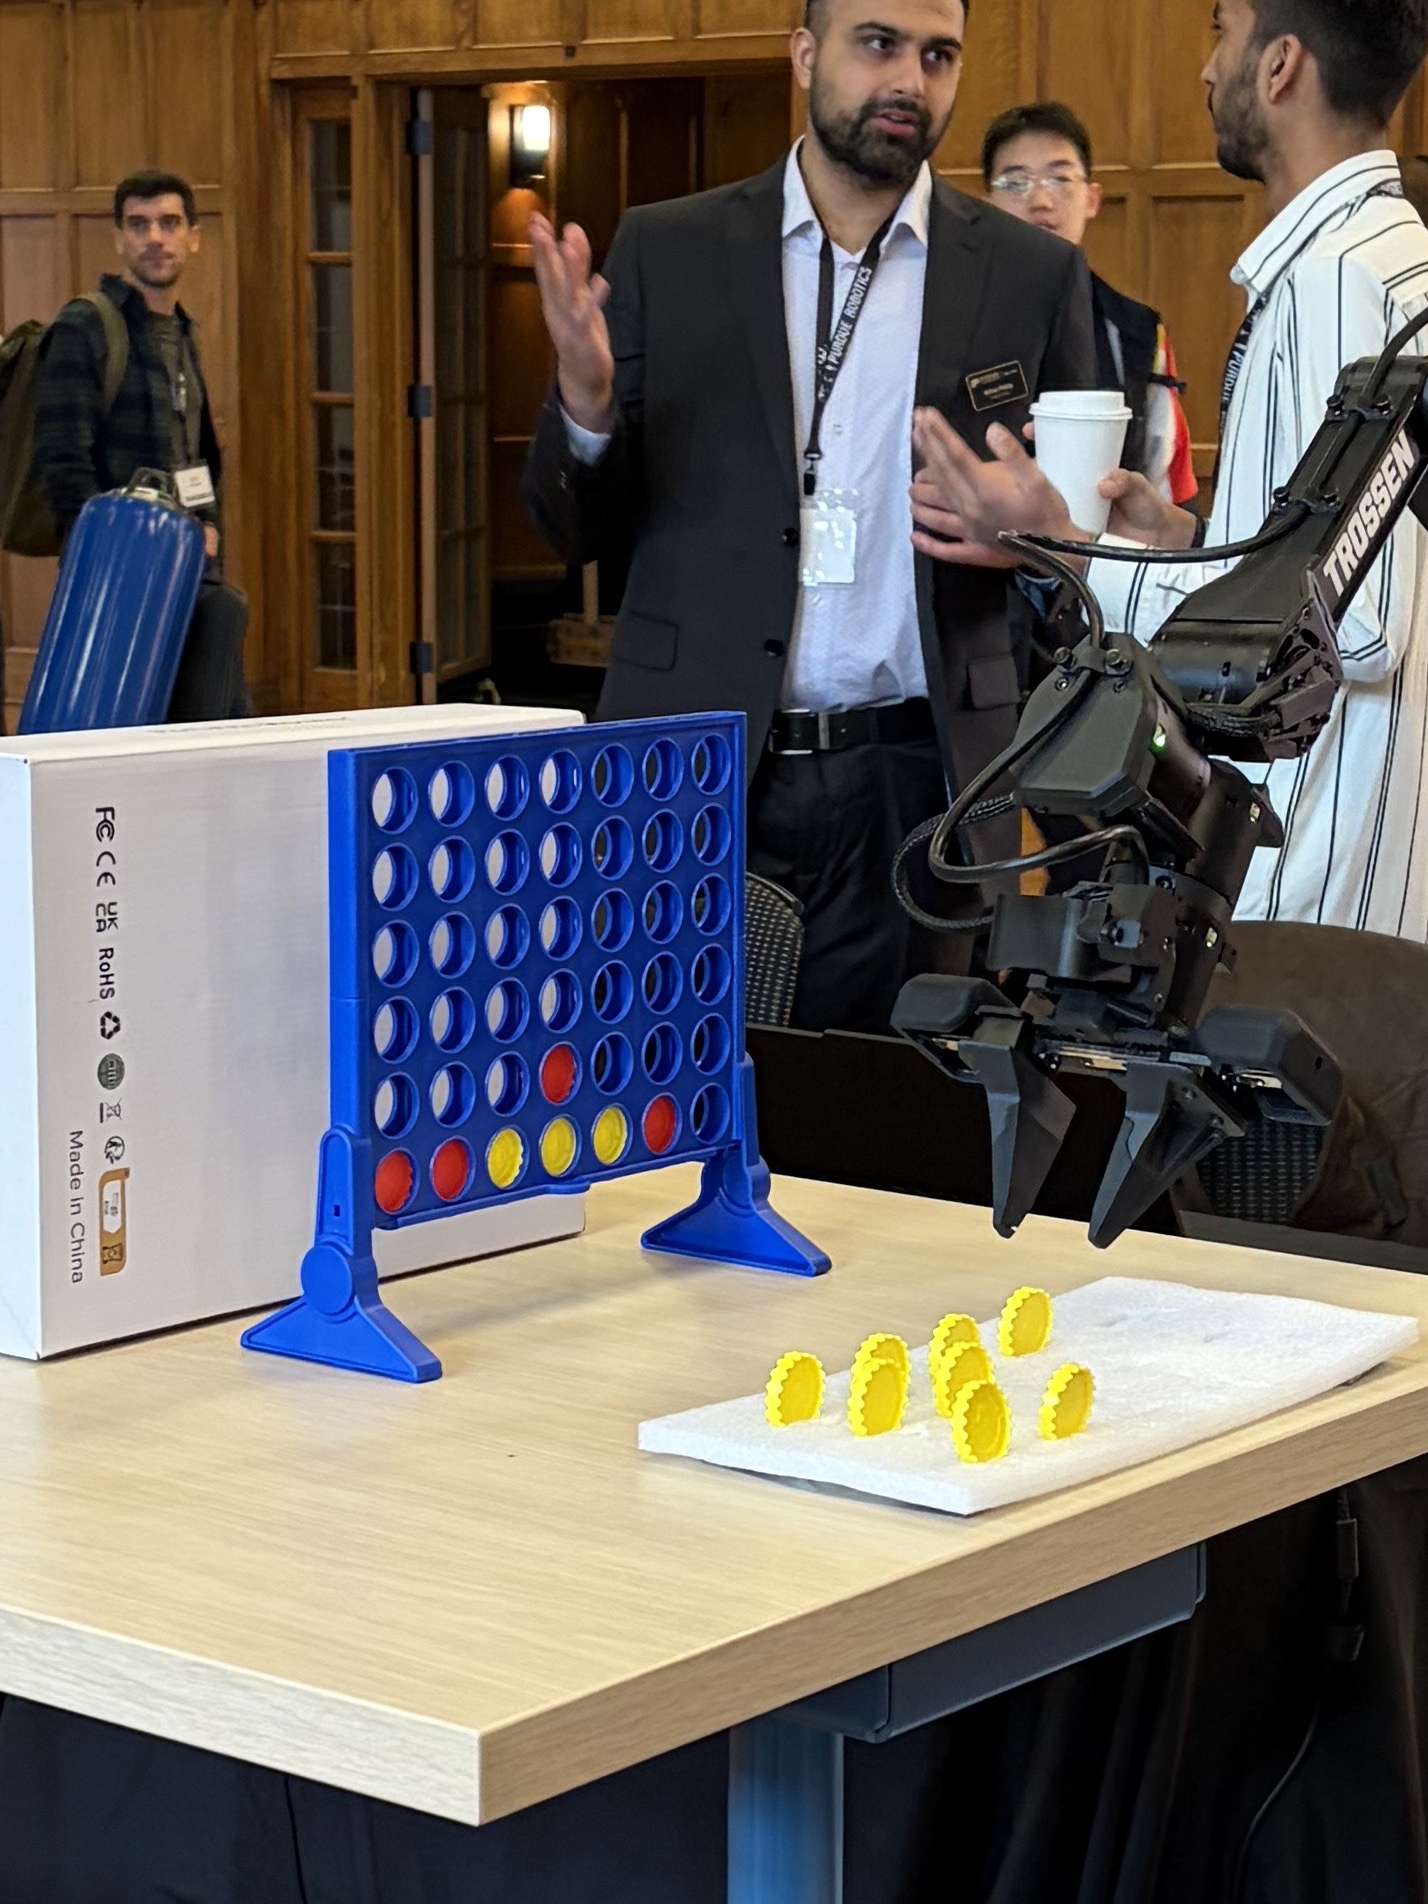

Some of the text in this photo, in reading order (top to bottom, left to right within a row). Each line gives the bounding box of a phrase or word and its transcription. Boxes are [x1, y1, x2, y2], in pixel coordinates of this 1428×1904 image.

[827, 265, 873, 365] PURDUE ROBOTICS
[1323, 429, 1415, 596] TROSSEN
[96, 850, 117, 887] CE
[98, 947, 116, 1000] RoHS
[69, 1130, 85, 1191] Made
[70, 1222, 86, 1284] China
